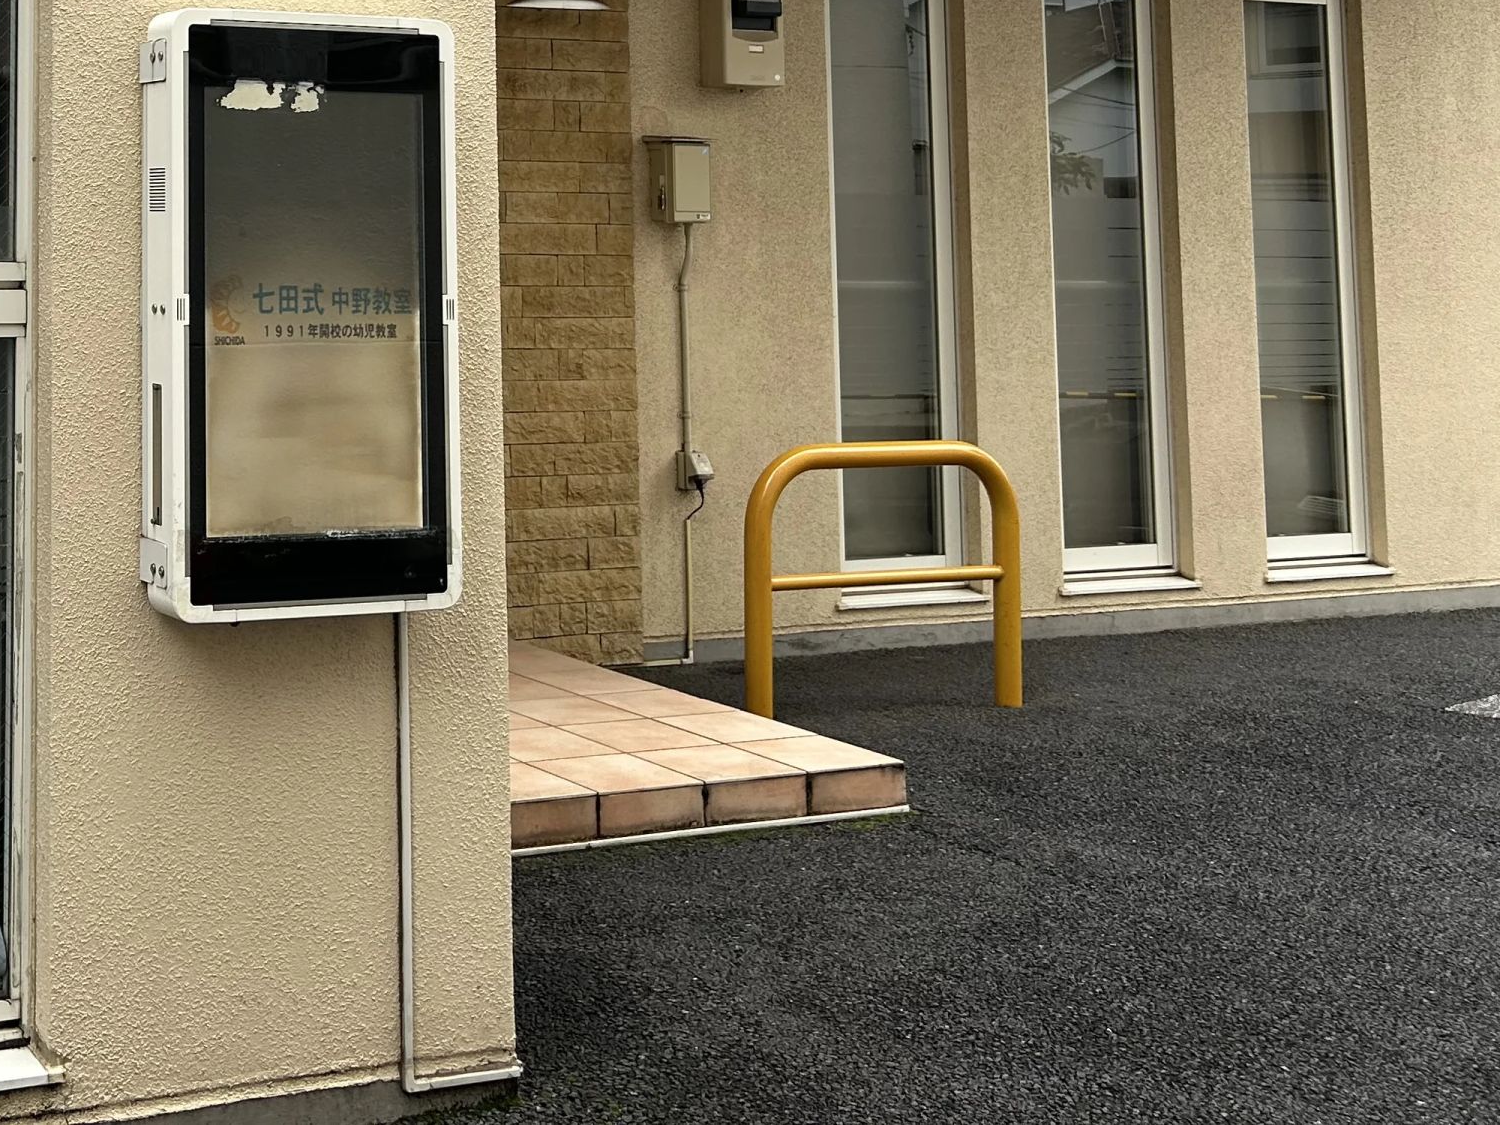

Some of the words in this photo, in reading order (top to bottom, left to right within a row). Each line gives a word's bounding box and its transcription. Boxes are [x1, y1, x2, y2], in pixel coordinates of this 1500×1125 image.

[252, 283, 324, 314] 七田式
[332, 286, 412, 315] 中野教室
[264, 323, 397, 338] 1991年開校の幼児教室
